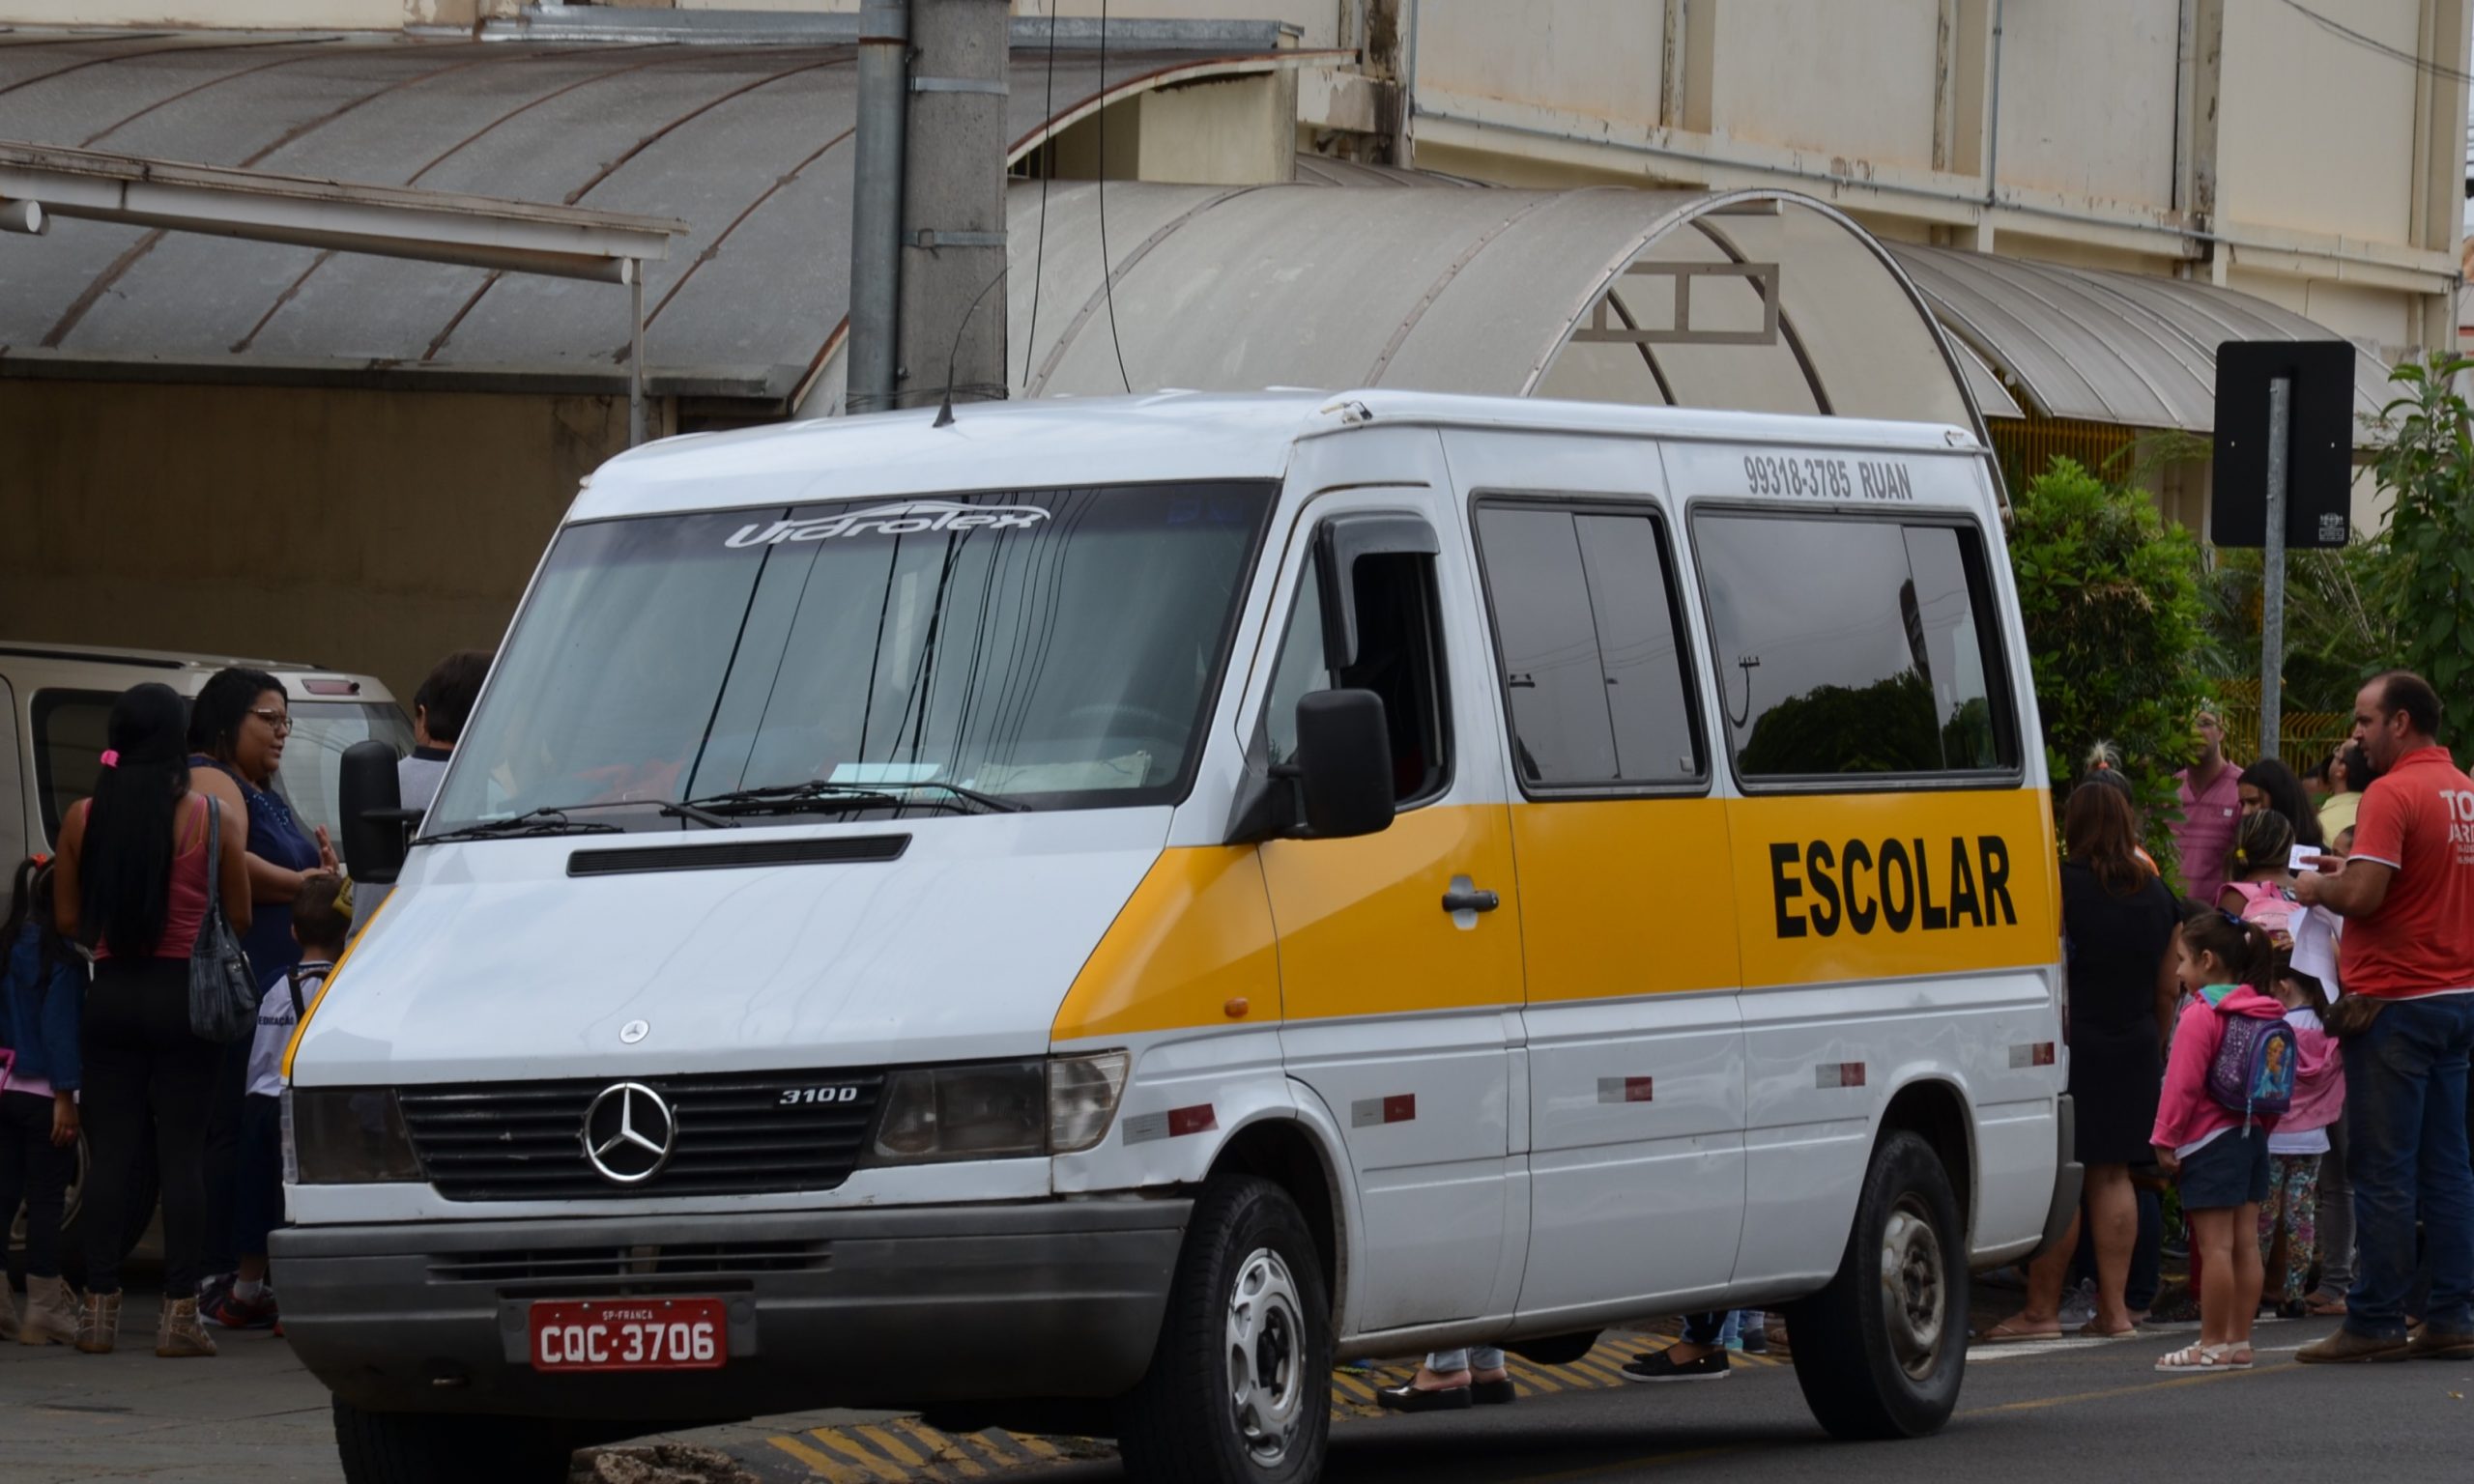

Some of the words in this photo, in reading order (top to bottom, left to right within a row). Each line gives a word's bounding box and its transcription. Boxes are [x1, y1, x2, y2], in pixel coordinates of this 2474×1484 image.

[1743, 455, 1852, 499] 99318-3785
[1857, 461, 1913, 500] RUAN
[1769, 835, 2018, 938] ESCOLAR
[779, 1087, 857, 1104] 310D
